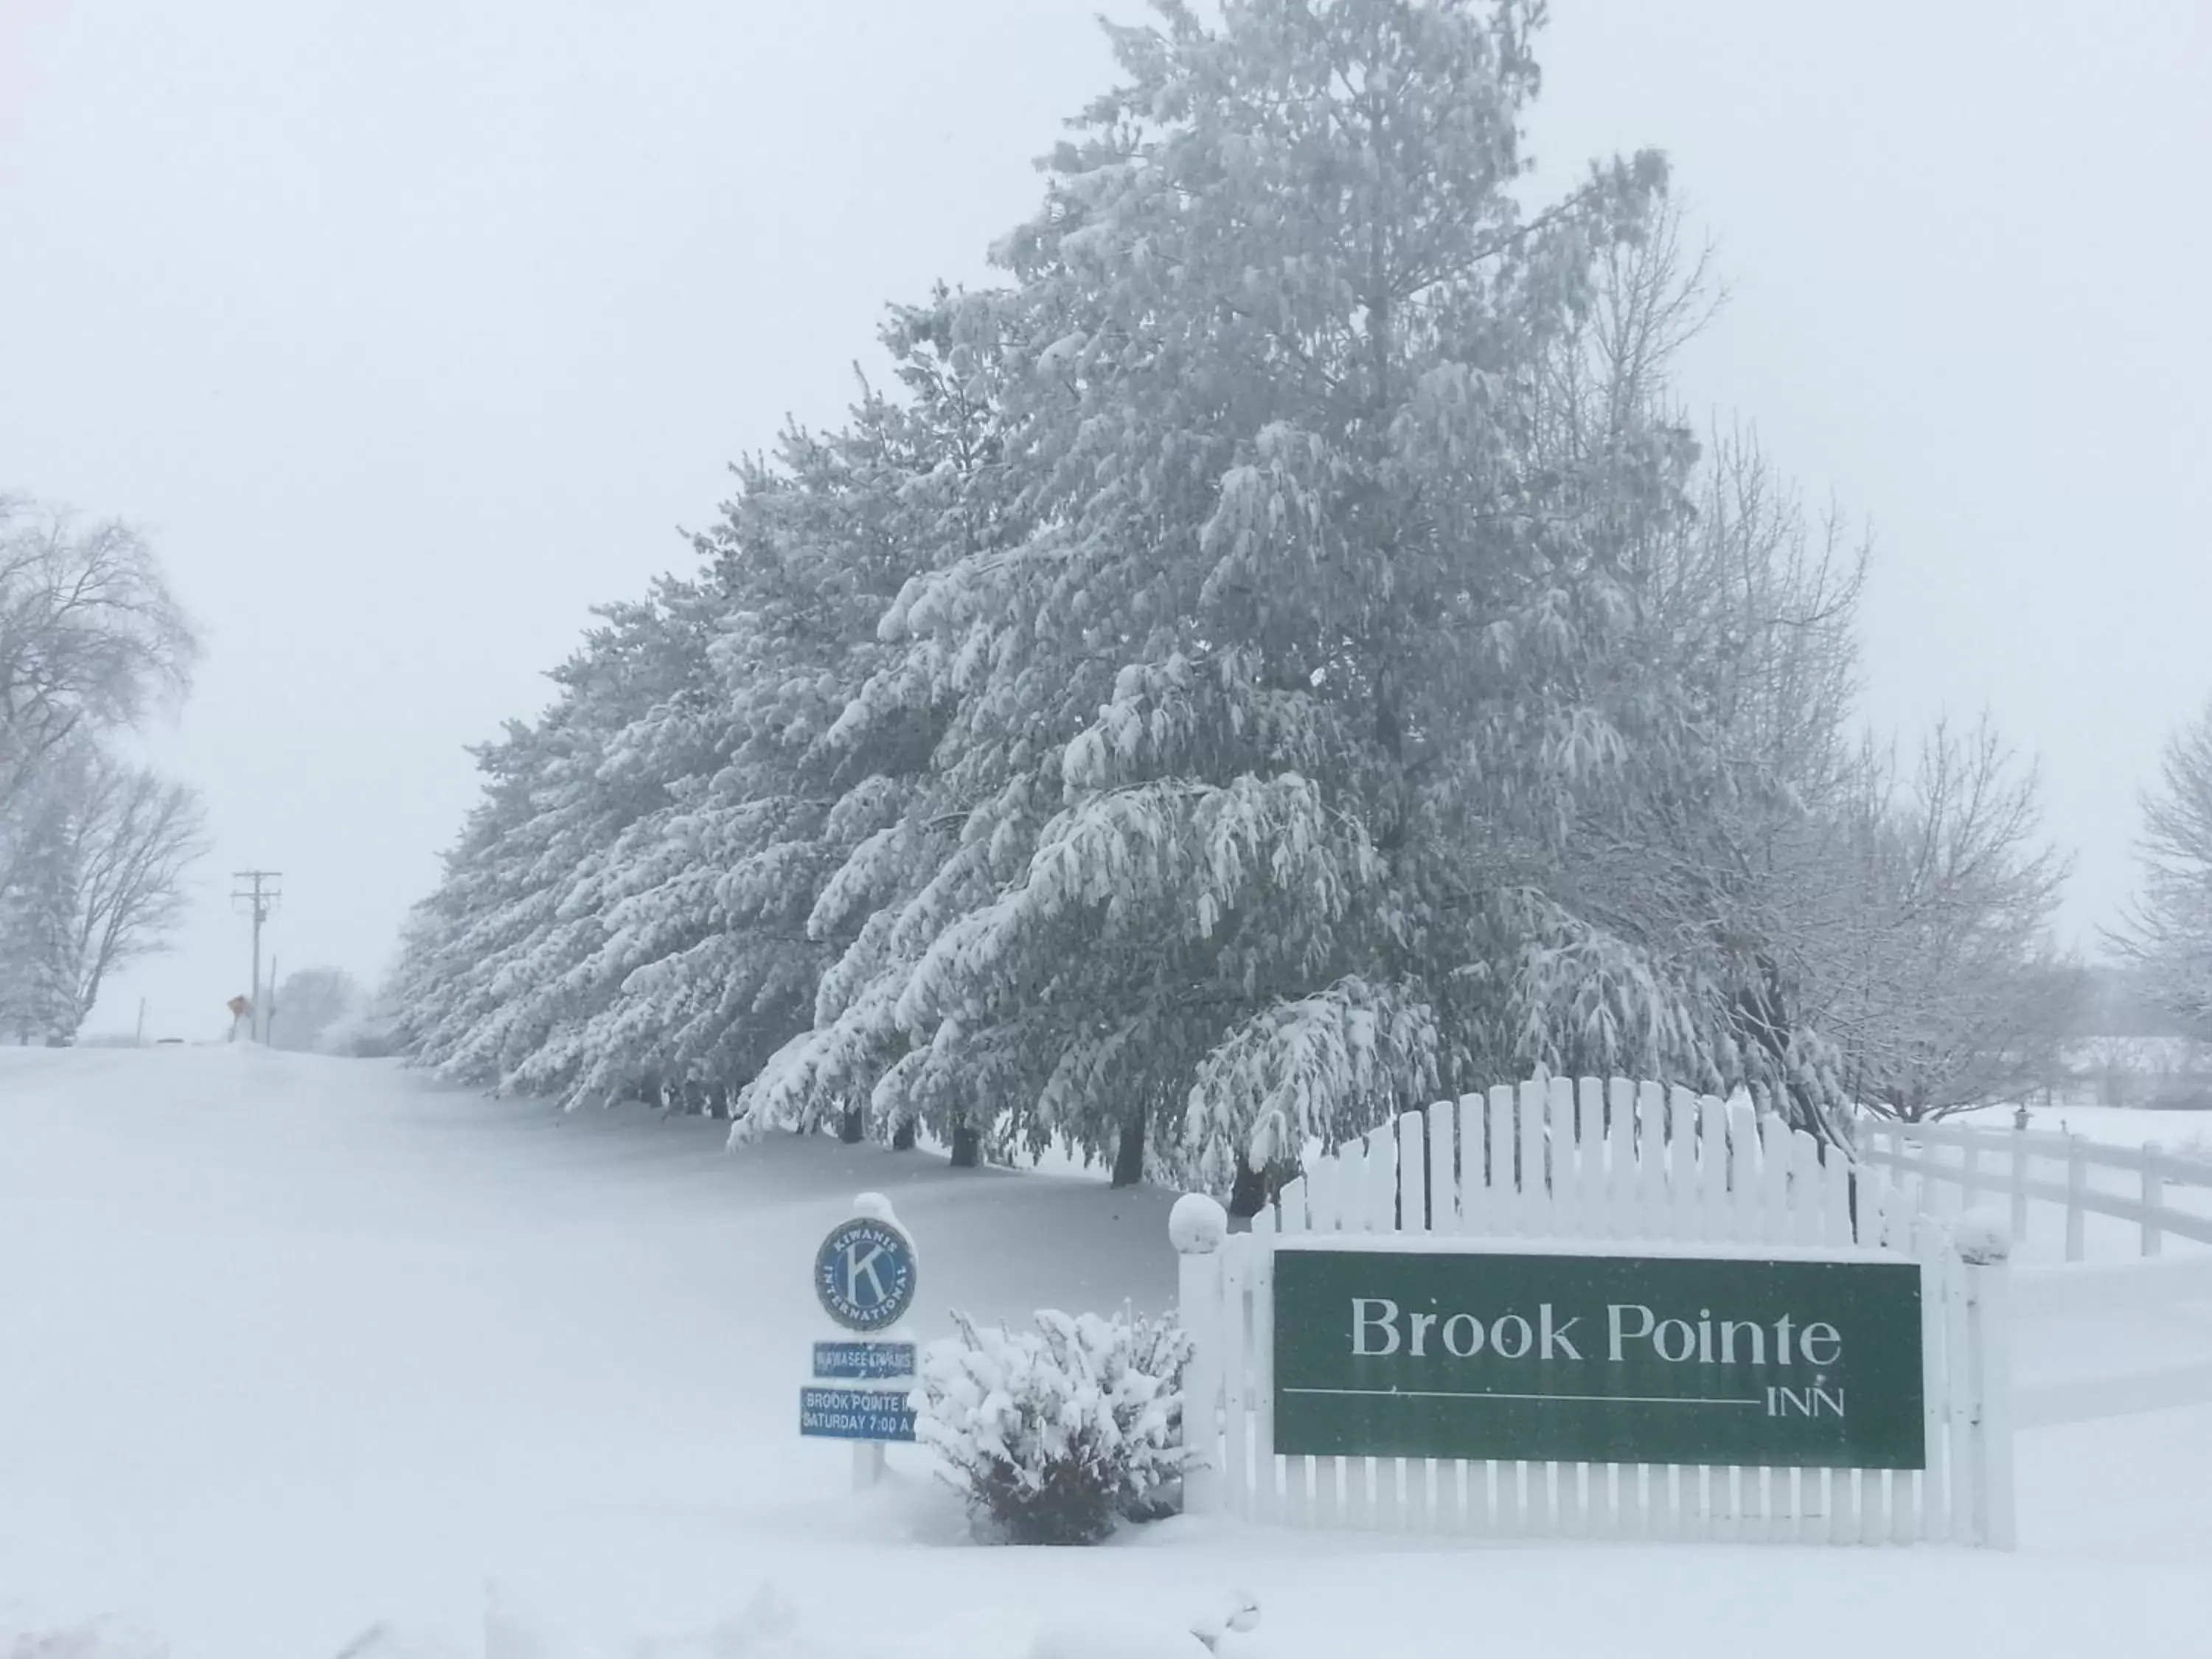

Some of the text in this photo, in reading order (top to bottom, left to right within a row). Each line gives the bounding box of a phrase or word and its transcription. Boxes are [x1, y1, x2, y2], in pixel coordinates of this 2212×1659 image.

[833, 1228, 898, 1252] KIWANIS
[846, 1242, 886, 1306] K
[823, 1265, 907, 1321] INTERNATIONAL
[1351, 1296, 1842, 1365] Brook Pointe
[807, 1392, 849, 1411] BROOK
[851, 1394, 899, 1413] POINTE
[1766, 1386, 1845, 1417] INN
[802, 1411, 866, 1430] SATURDAY
[869, 1414, 897, 1433] 7:00
